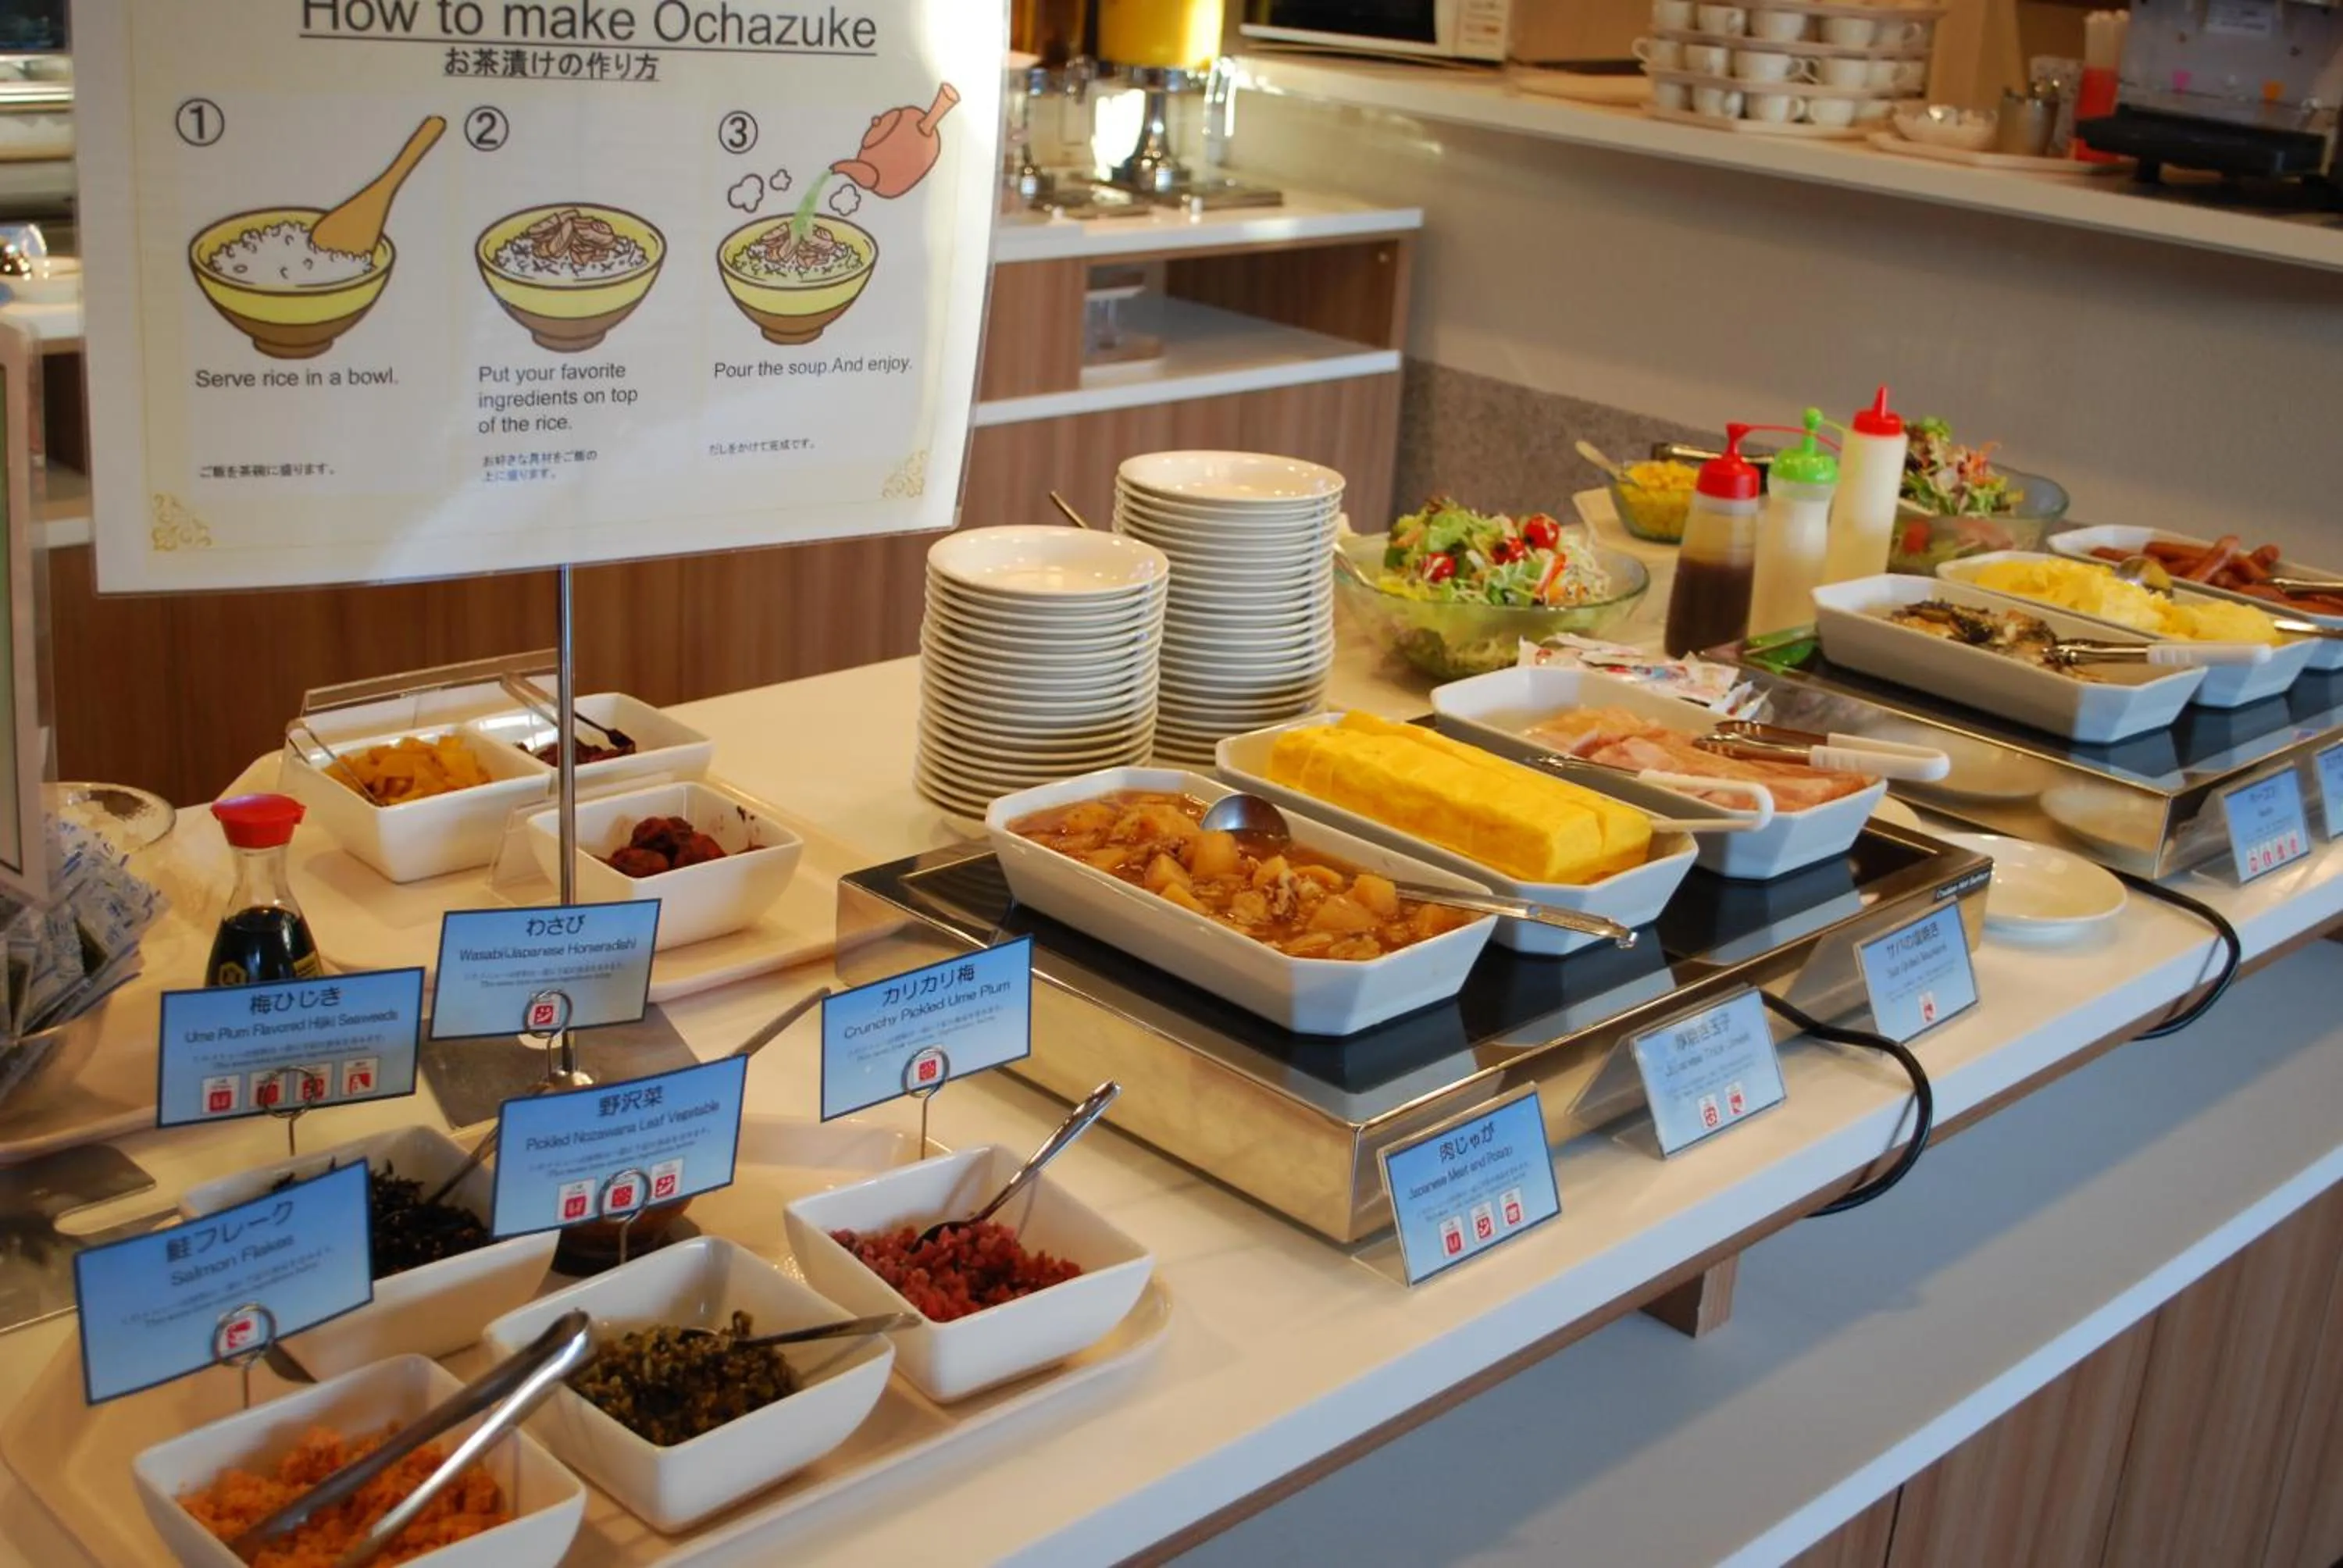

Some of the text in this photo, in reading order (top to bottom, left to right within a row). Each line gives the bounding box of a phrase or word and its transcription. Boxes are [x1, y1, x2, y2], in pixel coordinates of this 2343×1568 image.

[302, 0, 877, 48] How to make Ochazuke
[444, 48, 660, 79] お茶漬けの作り方
[194, 366, 399, 389] Serve rice in a bowl.
[478, 362, 626, 384] Put your favorite
[713, 362, 754, 379] Pour
[758, 360, 783, 376] the
[868, 357, 913, 376] enjoy.
[478, 387, 639, 412] ingredients on top
[478, 413, 572, 434] of the rice.
[526, 914, 586, 937] わさび
[882, 963, 975, 1007] カリカリ梅
[249, 986, 341, 1015] 梅ひじき
[843, 1014, 897, 1040] Crunchy
[900, 999, 945, 1023] Pickled
[947, 992, 977, 1008] Ume
[979, 979, 1011, 999] Plum
[597, 1085, 665, 1118] 野沢菜
[171, 1254, 237, 1287] Salmon
